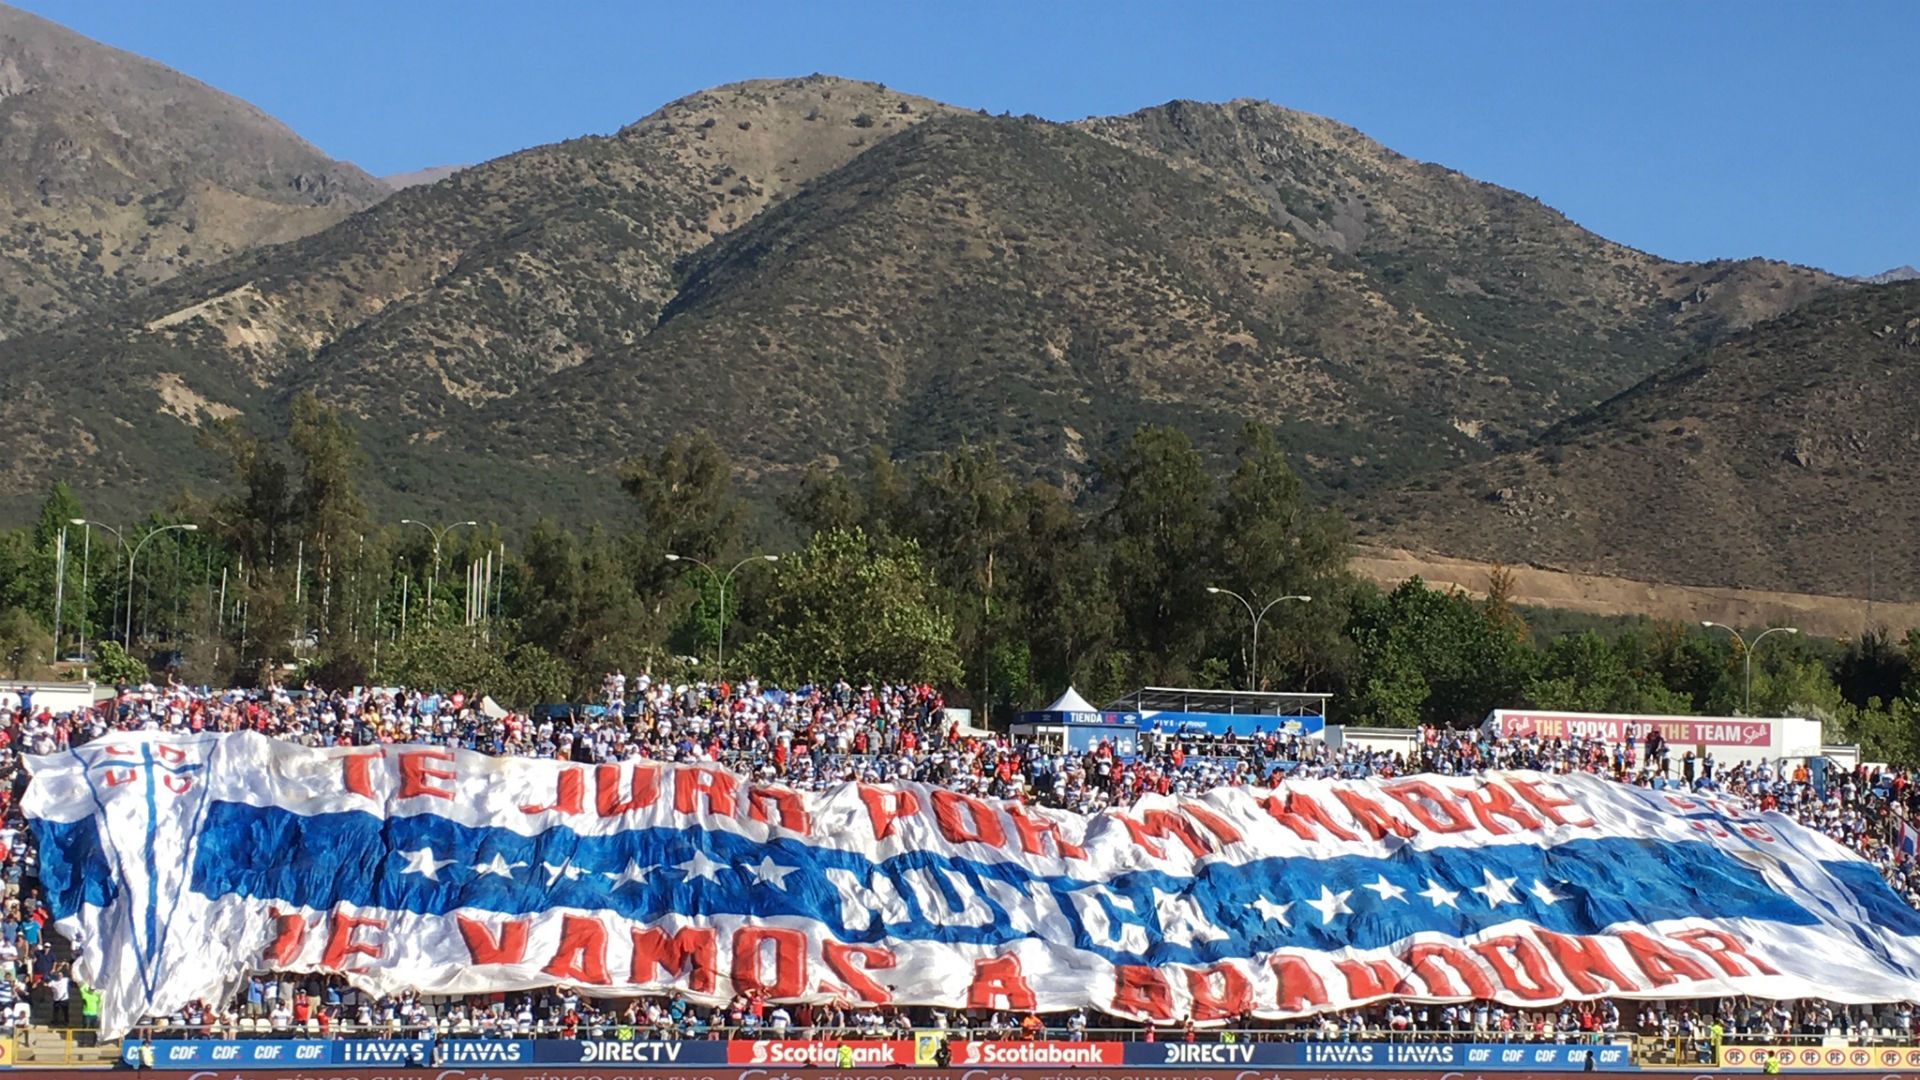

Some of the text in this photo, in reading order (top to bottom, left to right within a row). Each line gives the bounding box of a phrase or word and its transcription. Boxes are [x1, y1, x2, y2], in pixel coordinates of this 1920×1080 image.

[1070, 712, 1103, 724] TIENDA
[1534, 720, 1563, 736] THE
[1566, 721, 1618, 738] VODKA
[1658, 724, 1690, 740] THE
[1695, 724, 1741, 742] TEAM
[340, 748, 457, 800] TE
[1255, 777, 1597, 843] MADRE
[261, 906, 387, 973] TE
[455, 910, 897, 1005] VAMOS
[967, 950, 1037, 1011] A
[169, 1046, 198, 1060] CDF
[211, 1046, 240, 1060] CDF
[254, 1045, 283, 1059] CDF
[295, 1045, 324, 1059] CDF
[344, 1043, 521, 1061] HAVAS HAVAS
[580, 1041, 682, 1062] DIRECTV
[770, 1043, 895, 1063] Scotiaank
[983, 1043, 1103, 1063] Scotiabank
[1164, 1043, 1255, 1063] DIRECTV
[1306, 1045, 1454, 1063] HAVAS HAVAS
[1468, 1049, 1491, 1062] CDF
[1502, 1049, 1524, 1063] CDF
[1535, 1050, 1557, 1063] CDF
[1600, 1050, 1623, 1063] CDF
